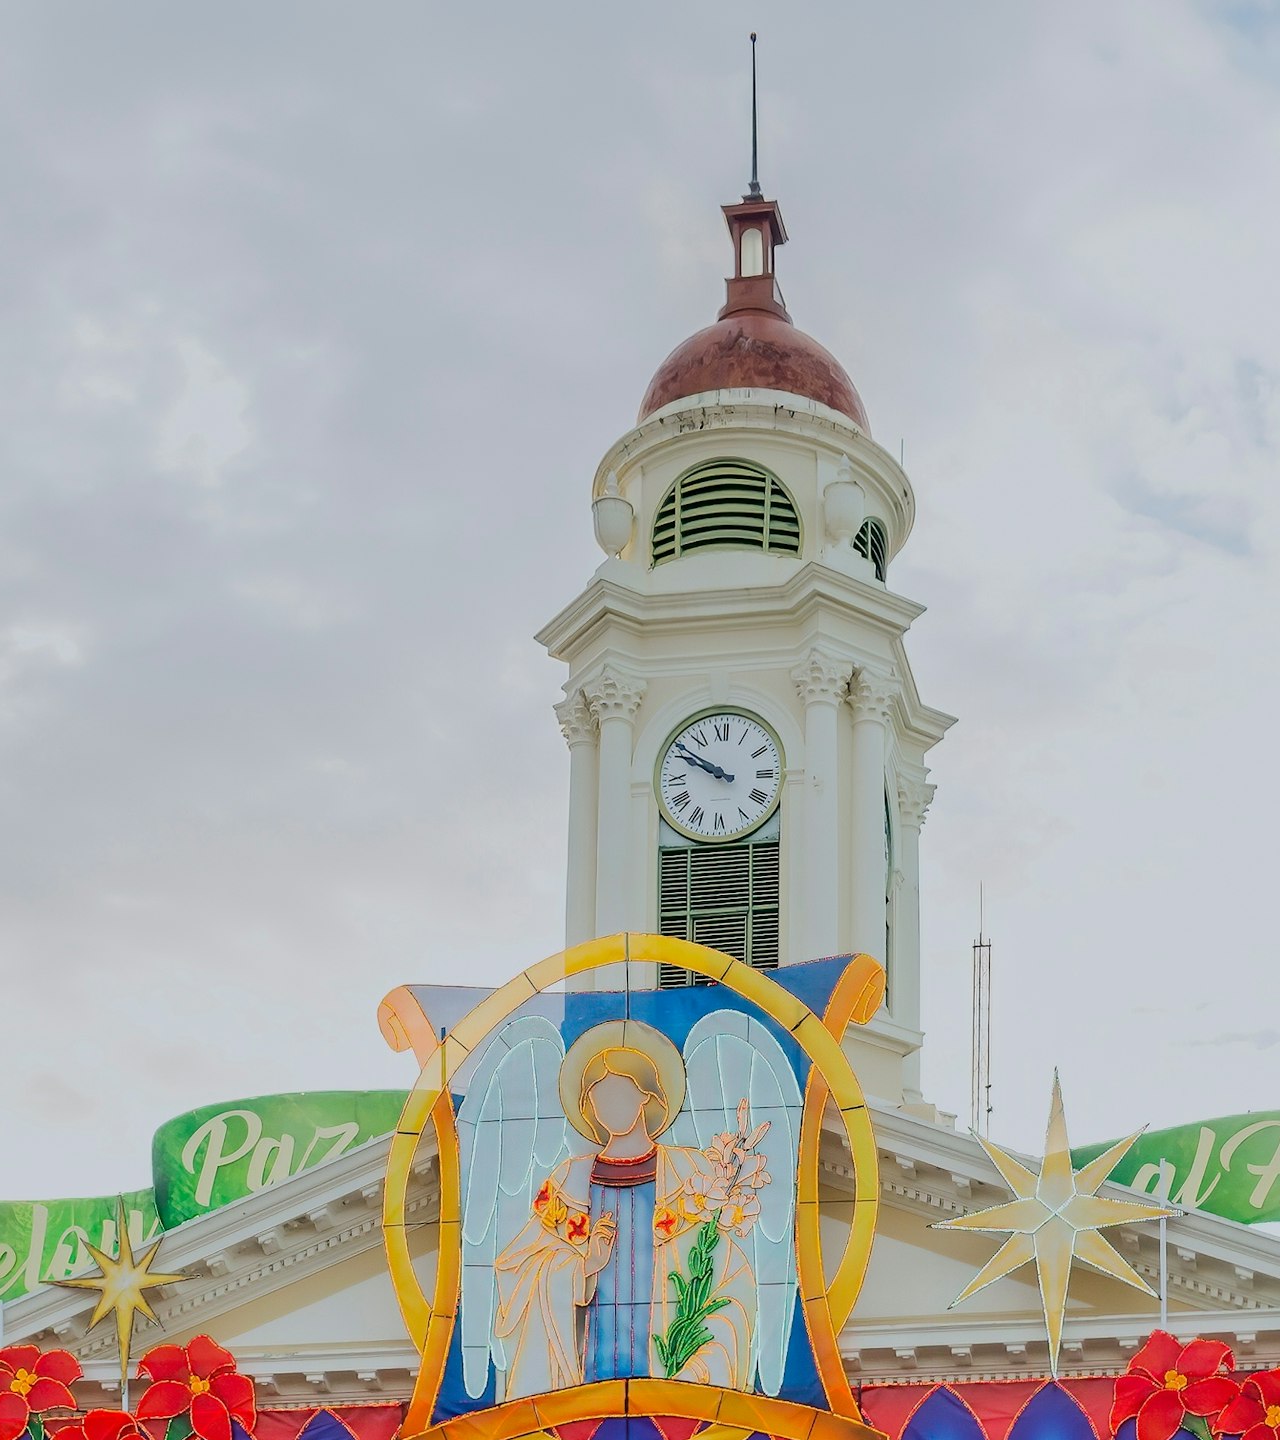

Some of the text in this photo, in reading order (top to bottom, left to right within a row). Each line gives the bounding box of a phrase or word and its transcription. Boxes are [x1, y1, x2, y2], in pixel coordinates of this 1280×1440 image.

[690, 728, 709, 750] XI
[713, 722, 729, 742] XII
[750, 745, 768, 759] II
[668, 773, 687, 787] IX
[756, 769, 774, 779] III
[181, 1109, 373, 1205] Paz
[1130, 1126, 1222, 1208] al
